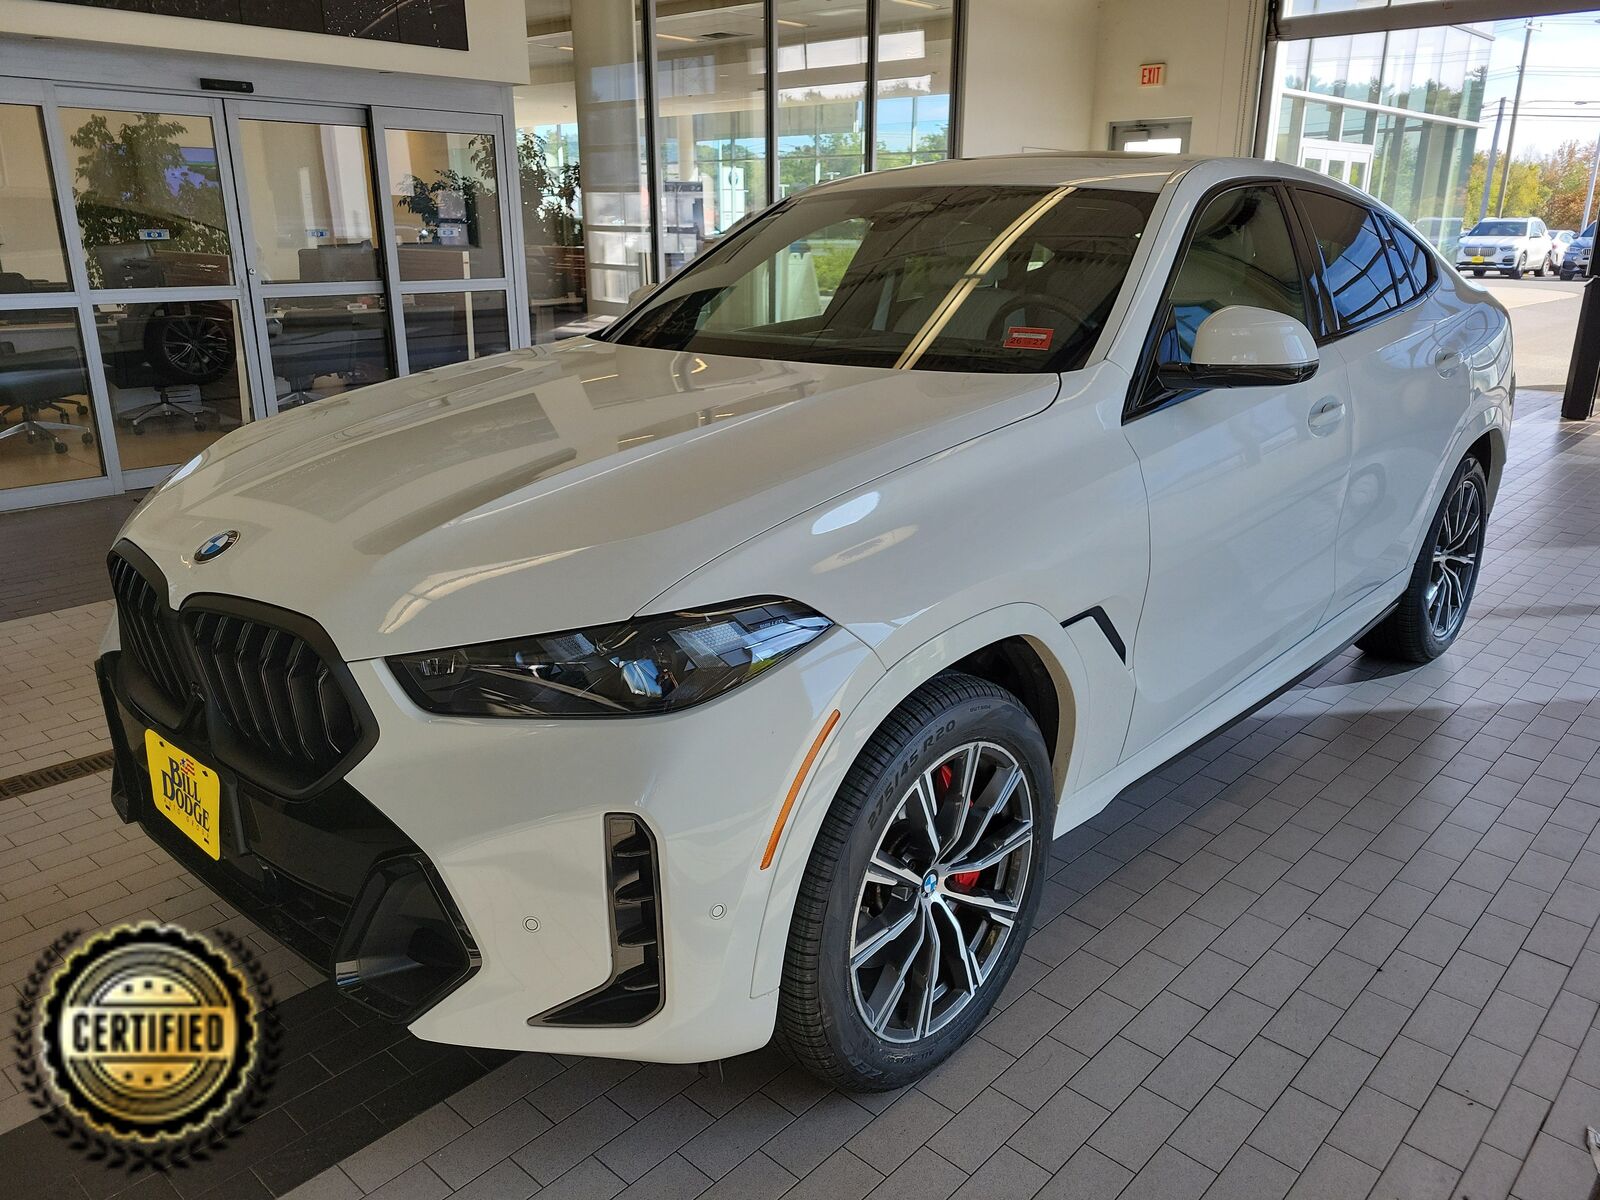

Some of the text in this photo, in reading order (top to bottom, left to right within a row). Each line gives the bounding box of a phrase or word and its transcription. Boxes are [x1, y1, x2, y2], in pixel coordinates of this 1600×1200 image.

[1141, 67, 1161, 85] EXIT
[161, 769, 210, 832] DODGE
[168, 756, 201, 803] BILL
[867, 749, 919, 831] 275/45
[923, 720, 956, 752] R20
